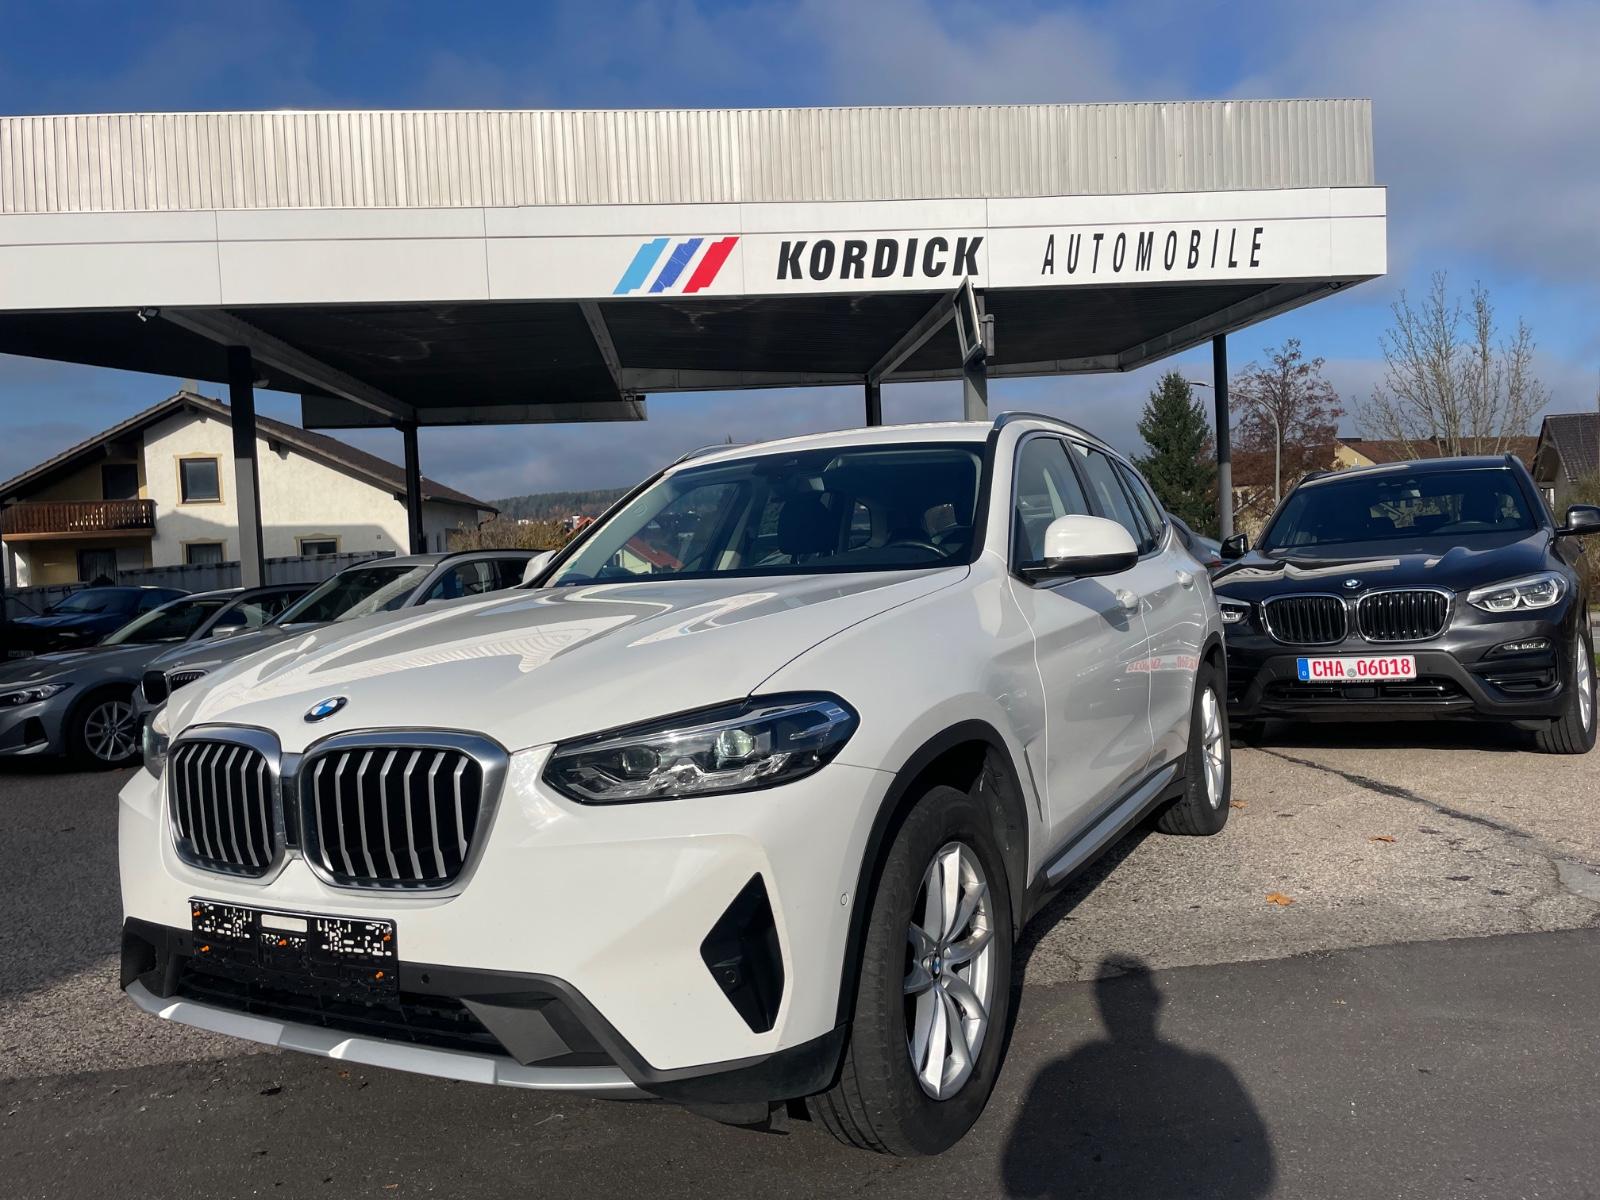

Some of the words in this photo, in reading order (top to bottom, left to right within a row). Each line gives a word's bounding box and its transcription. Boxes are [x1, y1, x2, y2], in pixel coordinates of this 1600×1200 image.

[776, 236, 984, 281] KORDICK
[1041, 226, 1264, 275] AUTOMOBILE
[1312, 660, 1345, 677] CHA
[1356, 658, 1411, 676] 06018
